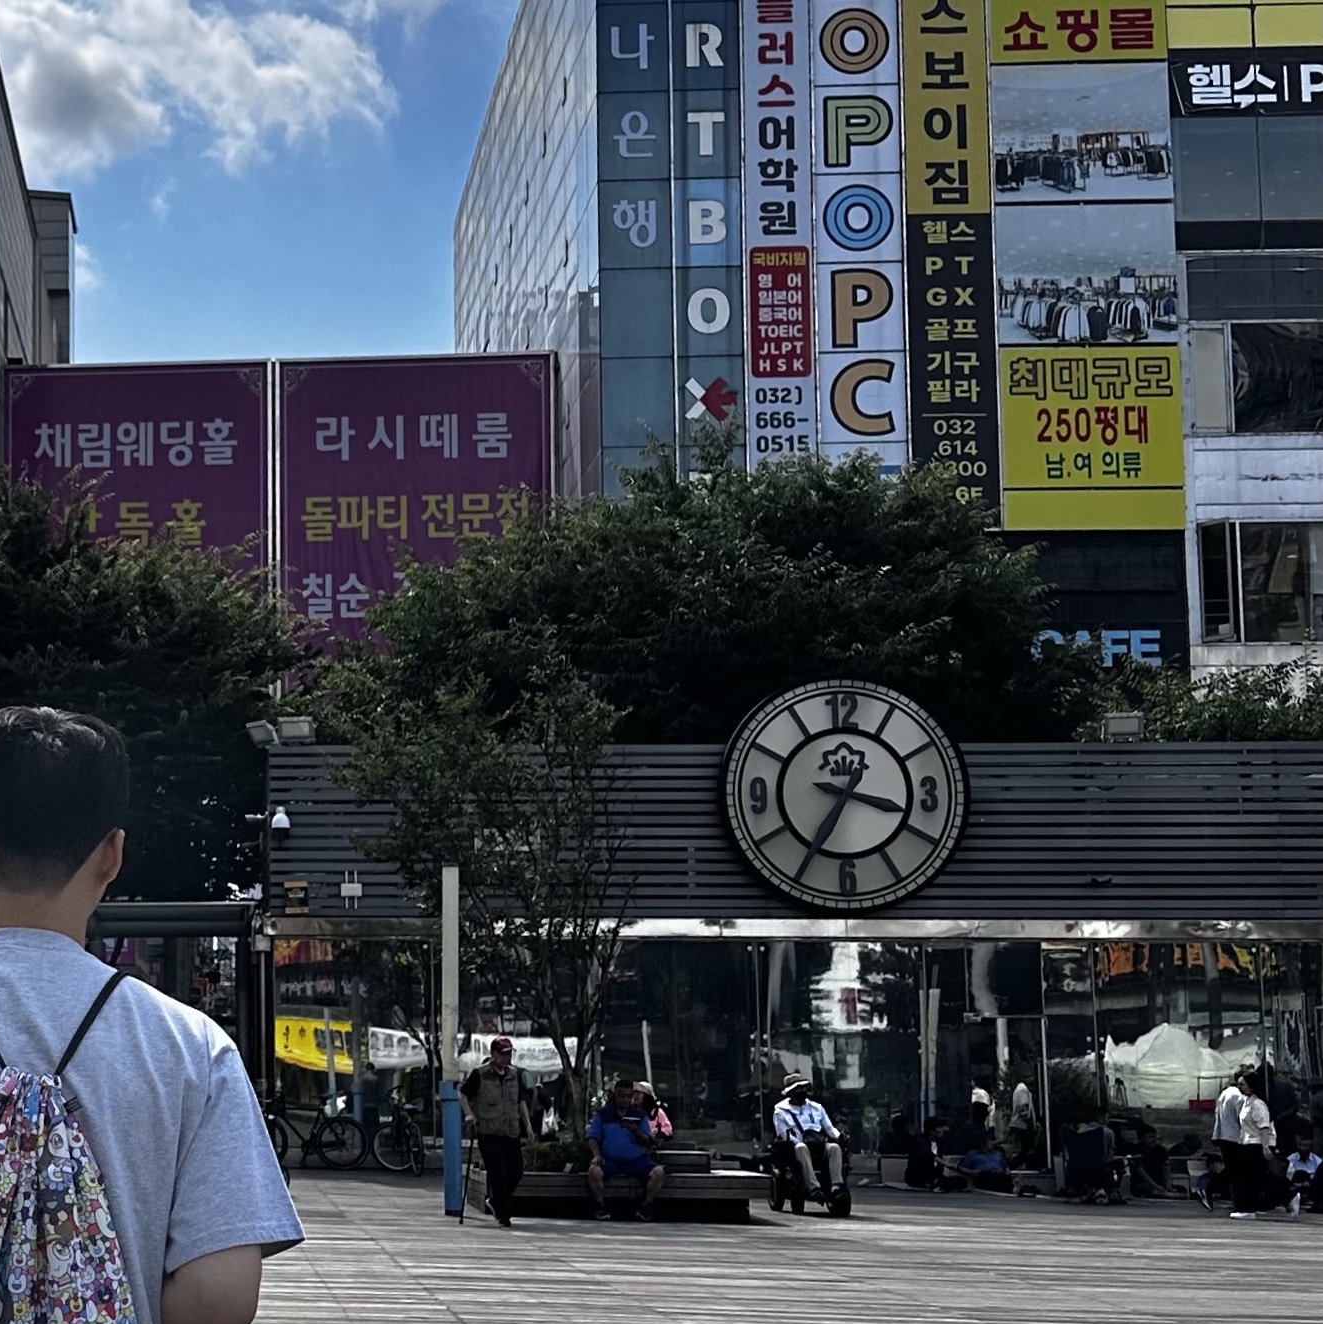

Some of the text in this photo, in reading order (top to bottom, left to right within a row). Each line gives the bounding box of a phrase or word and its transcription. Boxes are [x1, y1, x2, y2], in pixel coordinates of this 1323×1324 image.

[1003, 7, 1155, 53] 쇼핑몰
[1187, 63, 1277, 105] 헬스
[610, 22, 657, 248] 나은행
[922, 219, 976, 244] 헬스
[753, 252, 807, 267] 국비지원
[758, 289, 803, 305] 일본어
[758, 306, 803, 322] 중국어
[758, 324, 803, 338] TOEIC
[924, 318, 978, 342] 골프
[759, 341, 804, 355] JLPT
[759, 358, 804, 372] HSK
[927, 350, 980, 375] 기구
[1009, 355, 1174, 400] 최대규모
[755, 386, 803, 405] 032)
[927, 379, 980, 404] 필라
[756, 411, 809, 430] 666-
[933, 419, 976, 436] 032
[1037, 405, 1149, 446] 250평대
[34, 417, 238, 469] 채림웨딩홀
[315, 412, 513, 462] 라시떼룸
[756, 434, 810, 453] 0515
[1102, 451, 1143, 479] 의류
[301, 494, 409, 542] 돌파티
[1030, 629, 1163, 668] CFE
[824, 693, 859, 729] 12
[749, 775, 939, 815] 9 3
[838, 860, 857, 895] 6
